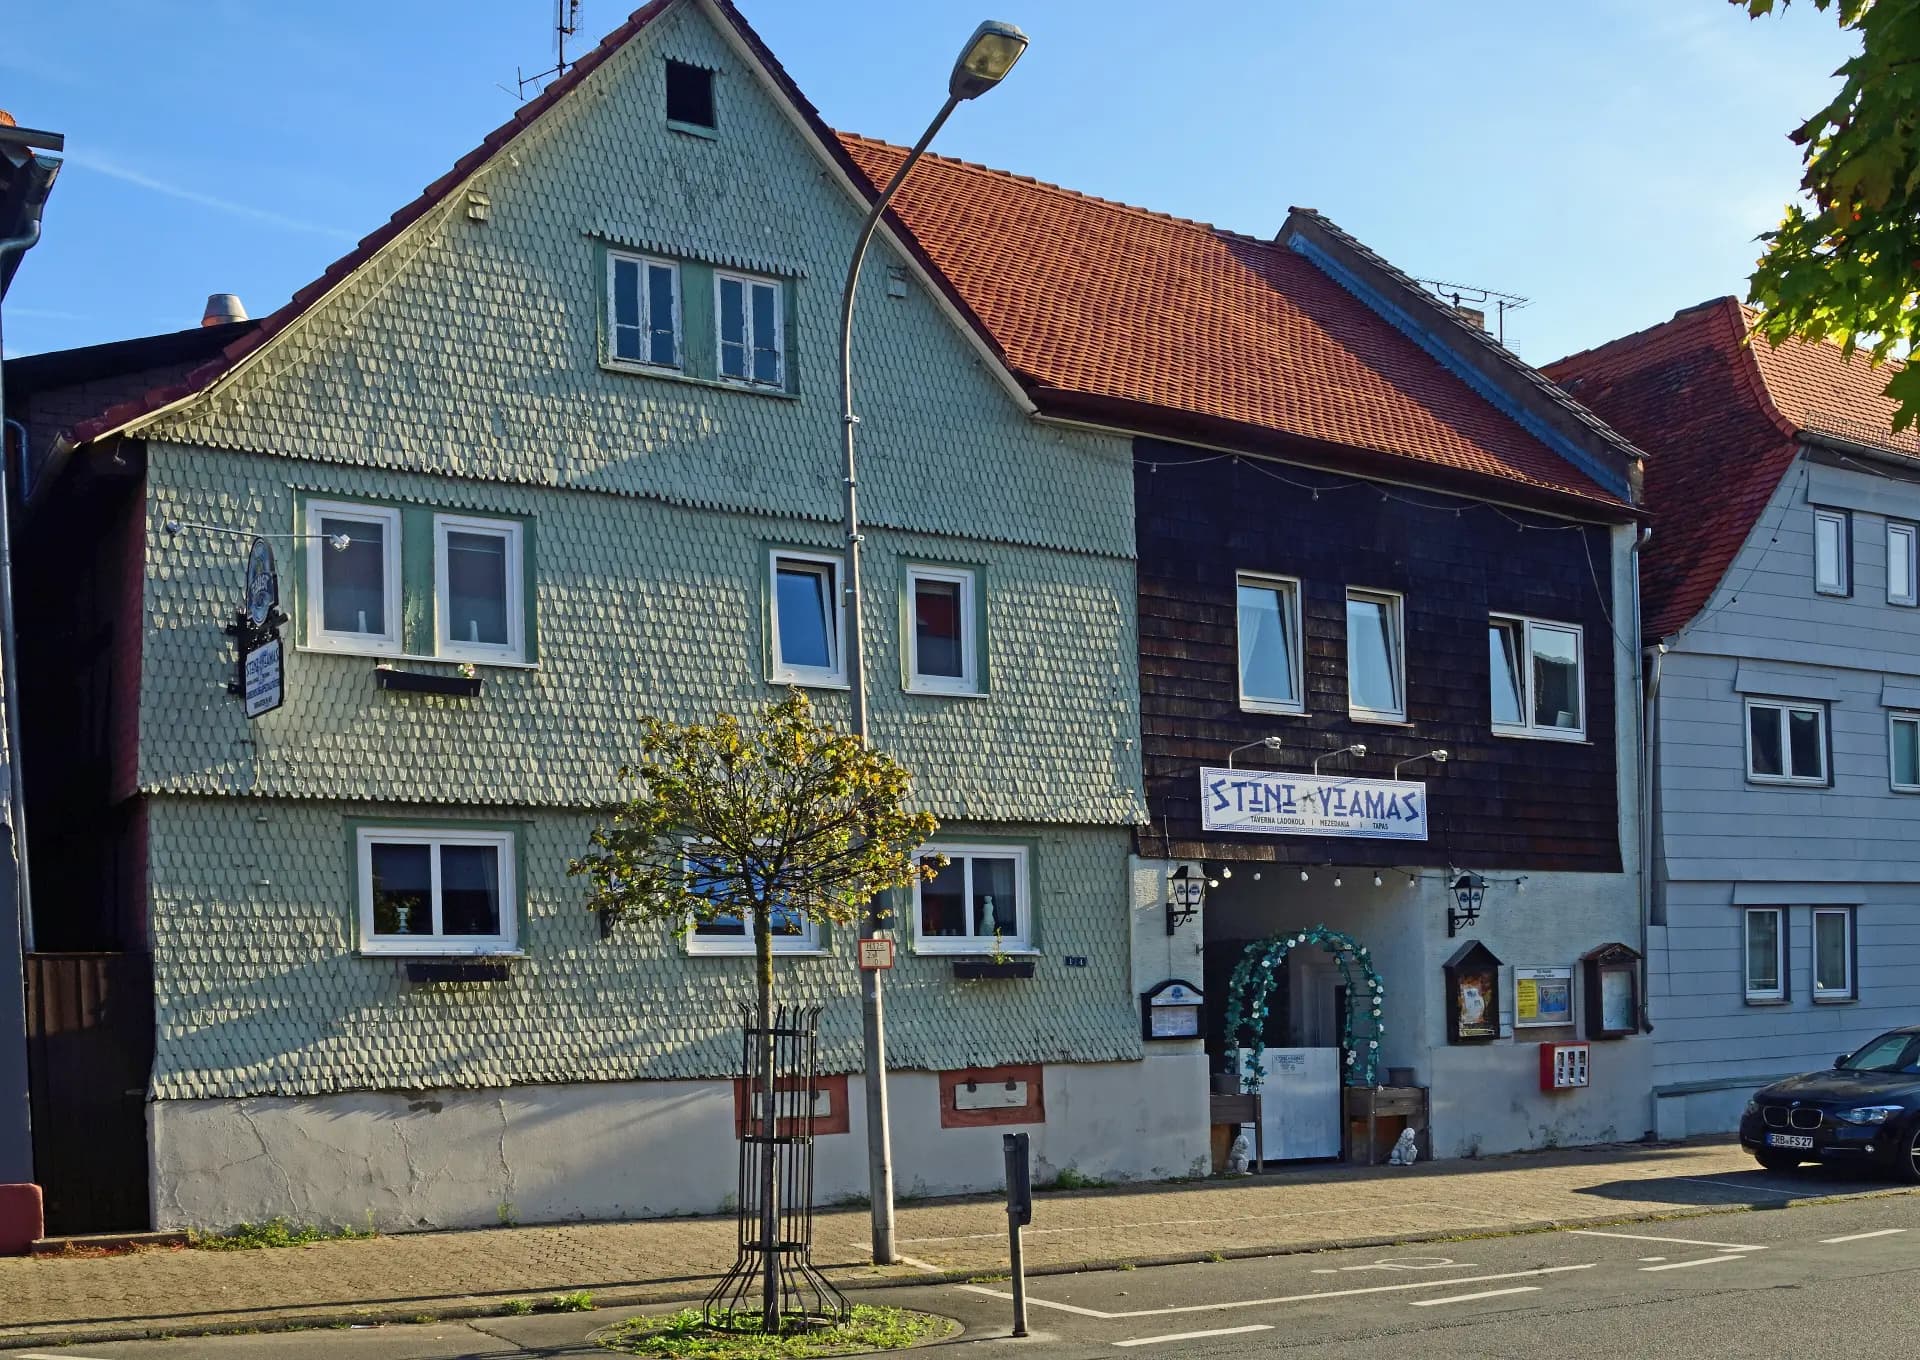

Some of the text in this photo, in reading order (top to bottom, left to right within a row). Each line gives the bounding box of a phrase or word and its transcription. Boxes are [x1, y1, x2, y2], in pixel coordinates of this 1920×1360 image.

[1209, 779, 1420, 822] STINI YIAMAS
[1250, 815, 1276, 824] TAVERNA
[1277, 818, 1306, 826] LADOKOLA
[1372, 822, 1389, 830] TAPAS
[1771, 1134, 1785, 1144] ERB
